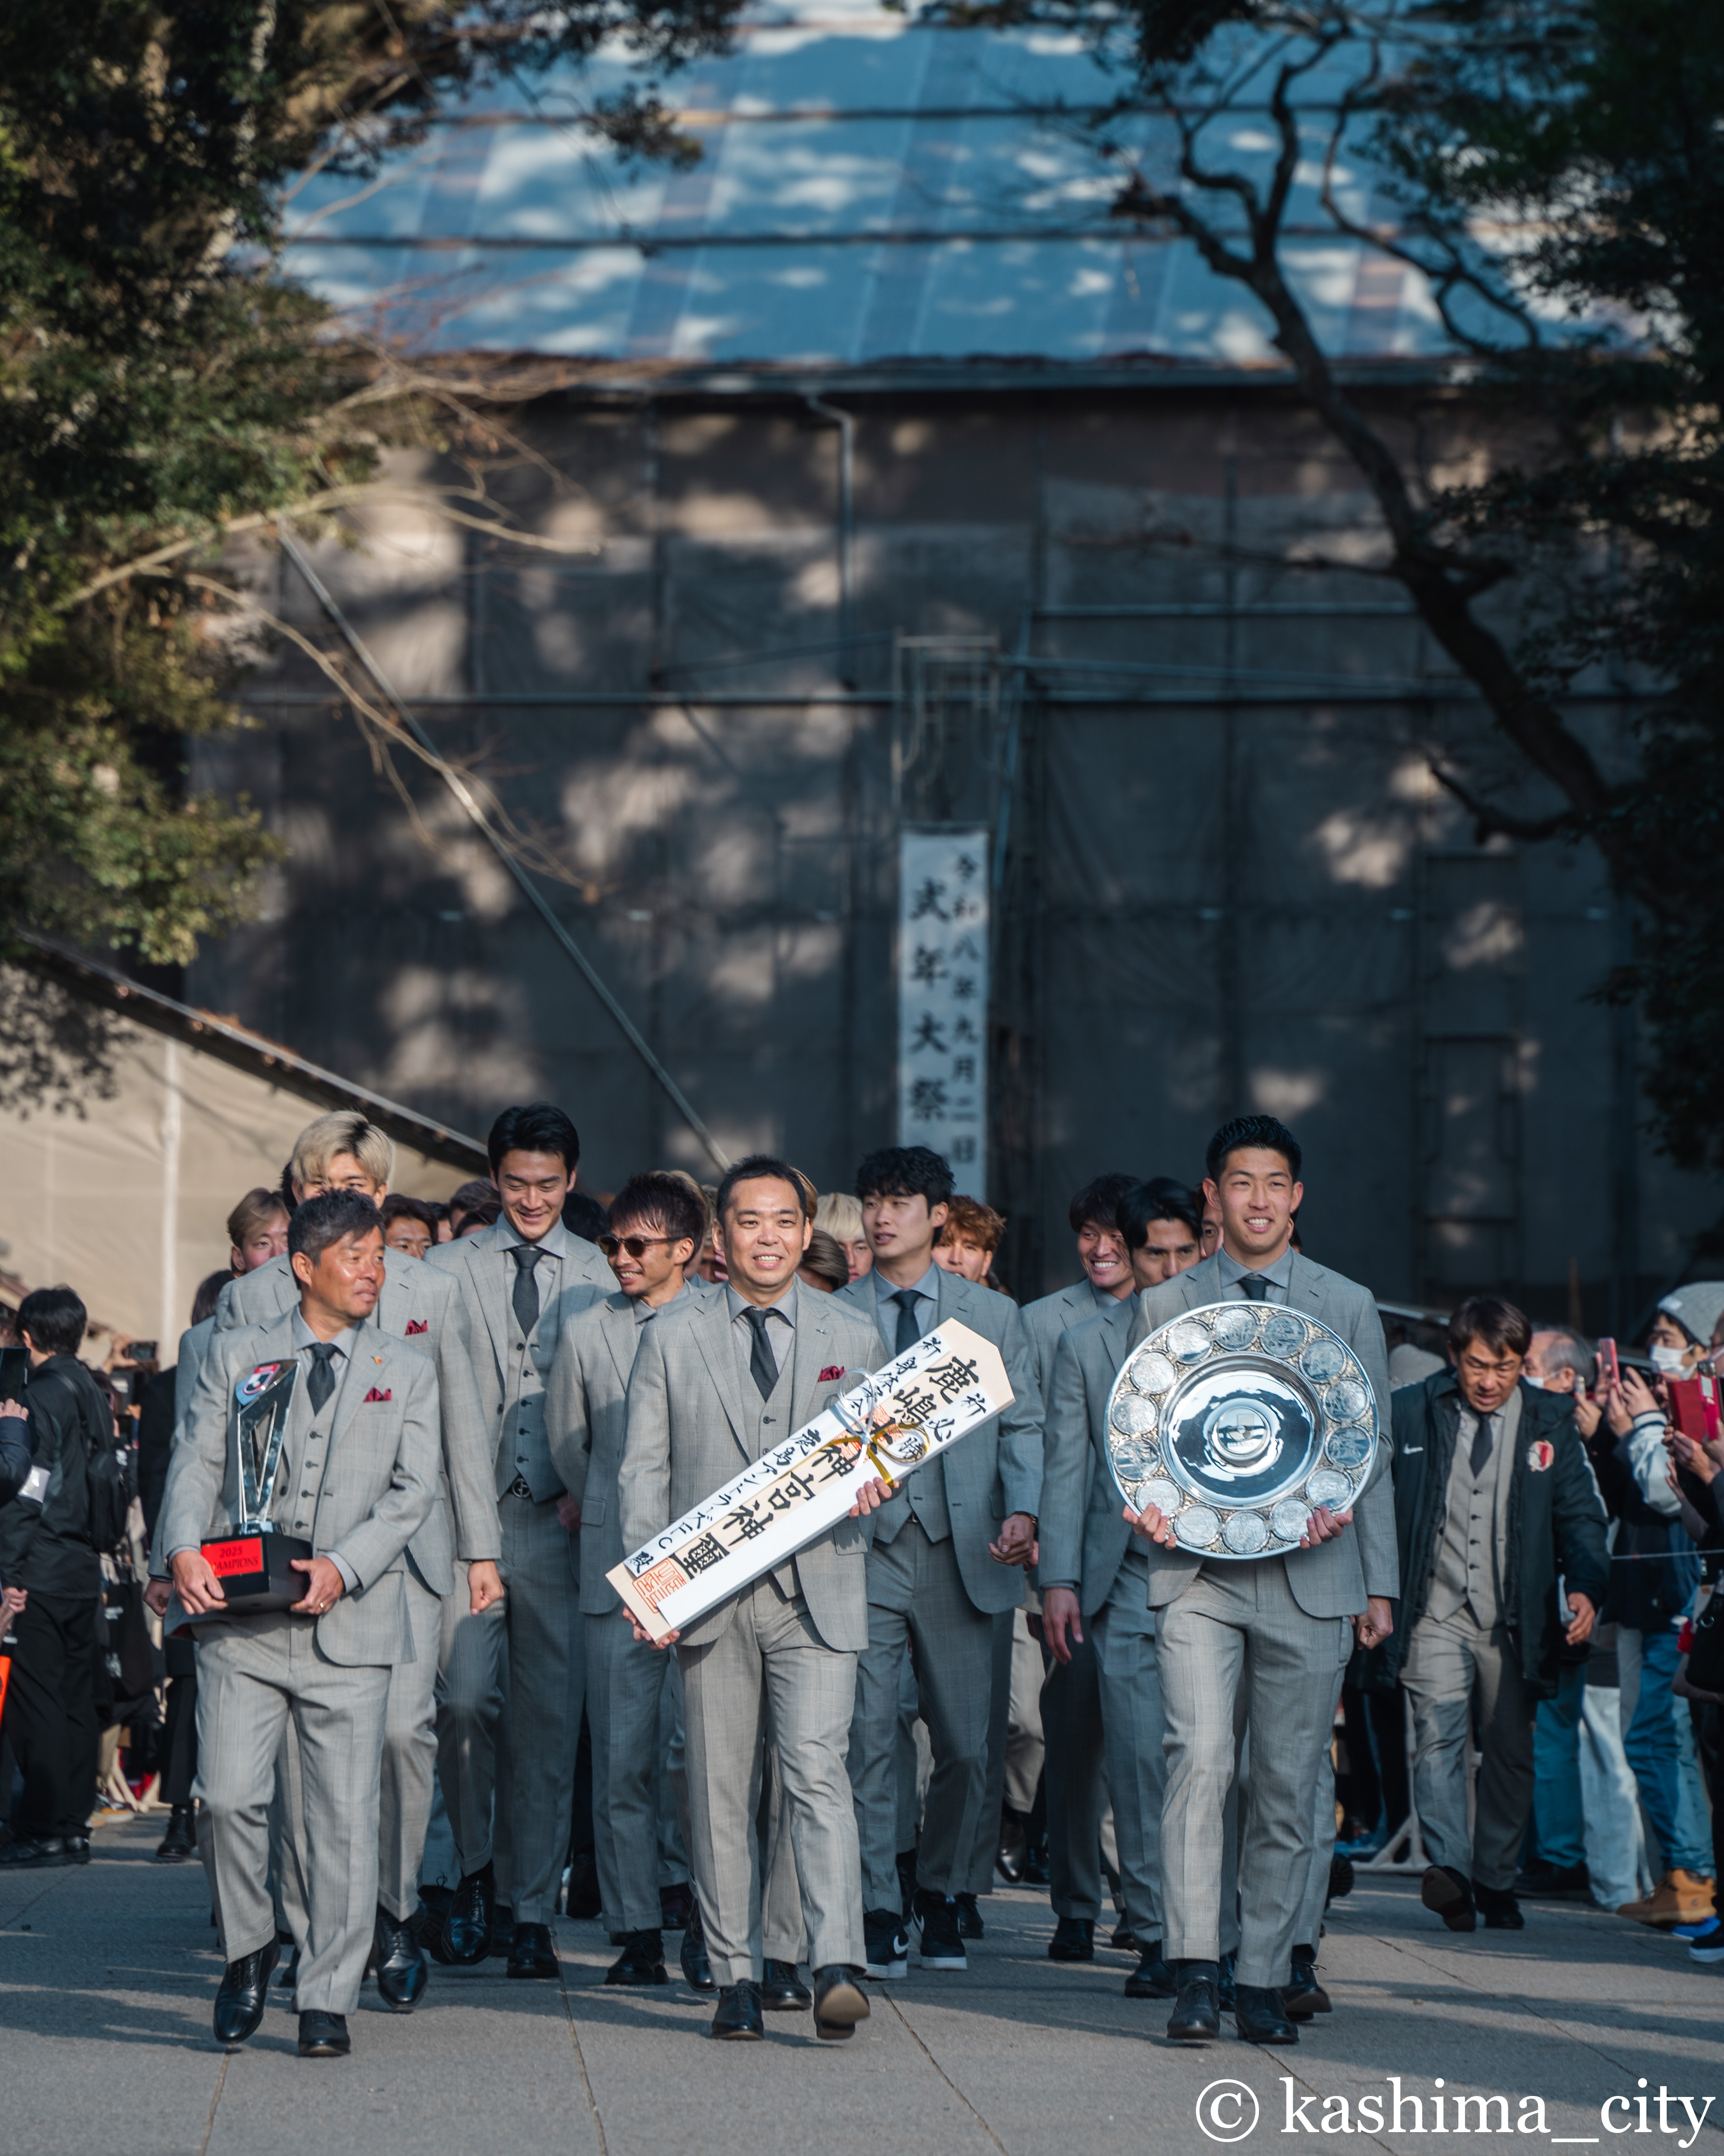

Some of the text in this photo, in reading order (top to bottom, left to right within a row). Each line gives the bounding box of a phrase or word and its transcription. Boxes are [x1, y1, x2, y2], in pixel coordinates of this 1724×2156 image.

[909, 877, 950, 1160] 式年大祭
[220, 1546, 243, 1558] 2025
[214, 1556, 258, 1570] AMPIONS
